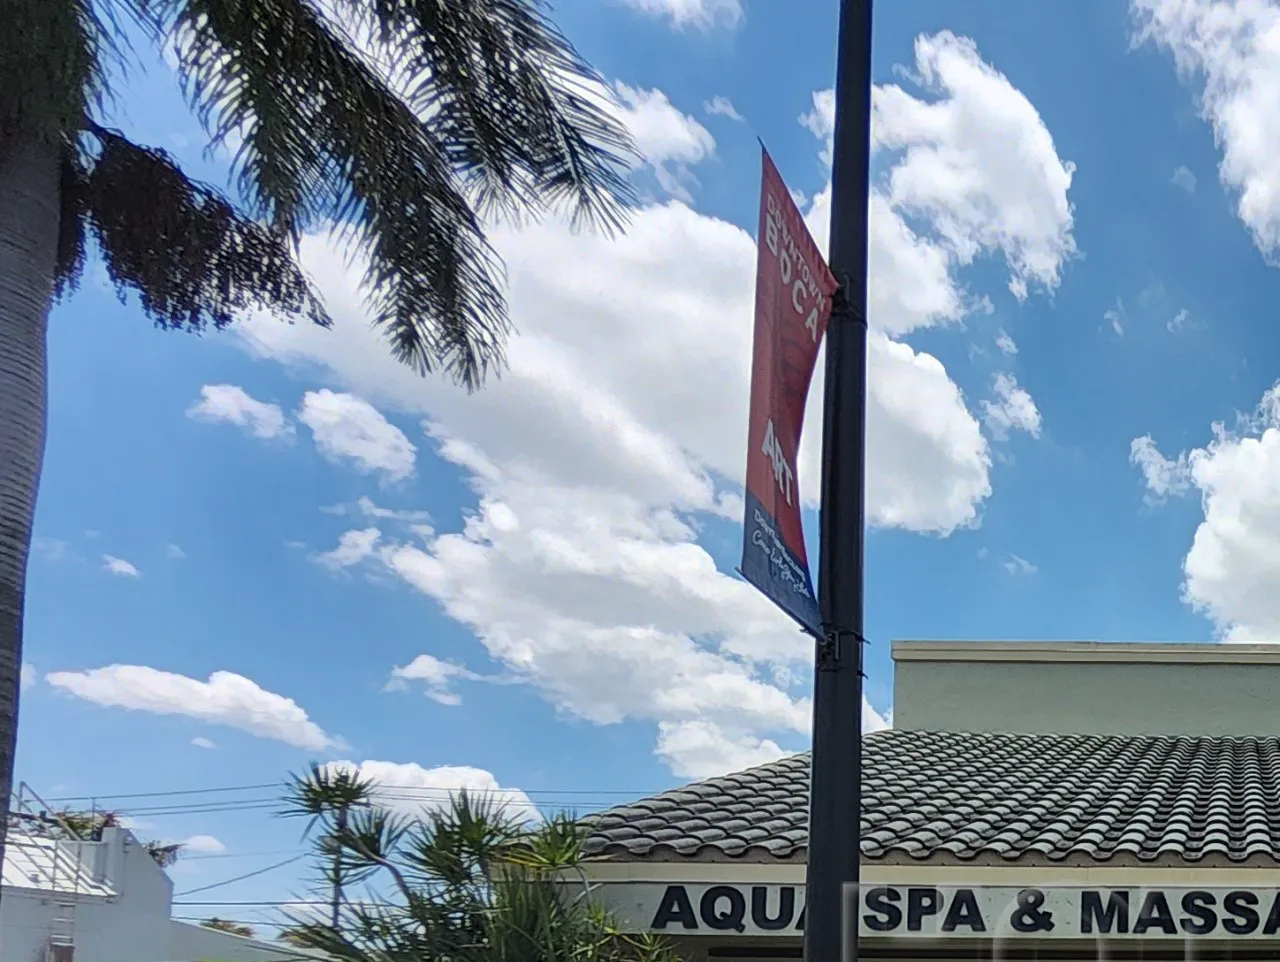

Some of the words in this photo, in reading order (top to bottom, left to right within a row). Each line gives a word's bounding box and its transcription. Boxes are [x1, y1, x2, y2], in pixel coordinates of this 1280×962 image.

[765, 212, 819, 342] BOCA
[767, 193, 826, 312] DOWNTOWN
[761, 418, 793, 506] ART
[651, 886, 806, 932] AQU
[863, 888, 986, 932] SPA
[1010, 888, 1055, 932] &
